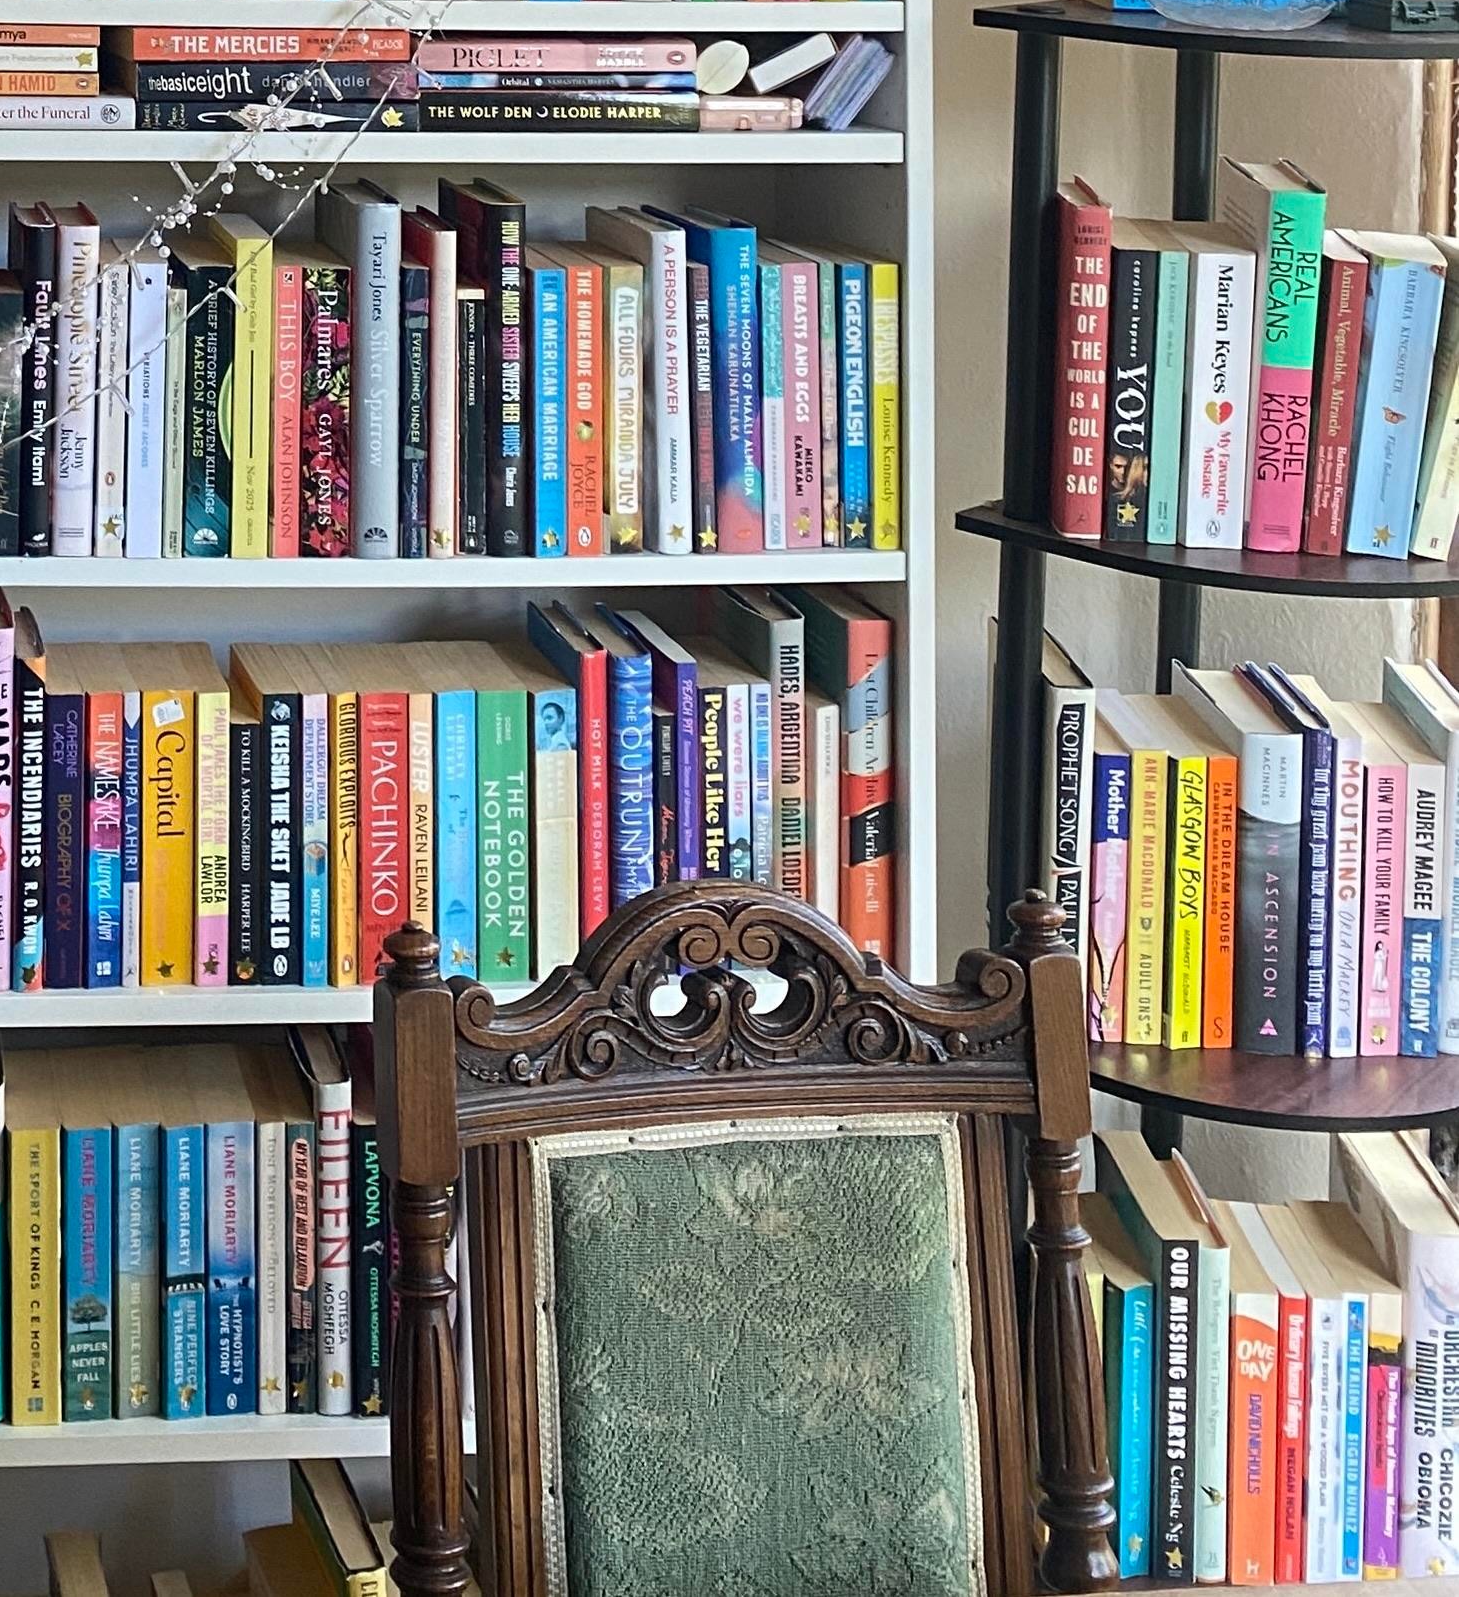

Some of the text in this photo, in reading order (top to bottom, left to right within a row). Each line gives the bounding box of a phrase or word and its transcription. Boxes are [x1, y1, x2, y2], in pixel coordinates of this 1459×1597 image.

[429, 106, 662, 120] THE WOLF DEN ELODIE HARPER
[1213, 264, 1234, 394] Marian Keyes
[1265, 211, 1293, 343] AMERICANS
[1294, 253, 1317, 306] REAL
[315, 290, 338, 390] Palmares
[794, 275, 809, 422] BREASTS AND EGGS
[845, 279, 863, 446] PIGEON ENGLISH
[317, 414, 331, 525] GAYL JONES
[1257, 392, 1284, 481] KHONG
[1282, 394, 1308, 483] RACHEL
[371, 740, 398, 916] PACHINKO
[701, 694, 723, 871] People Like Her
[415, 804, 428, 912] RAVEN LEILANI
[484, 781, 501, 928] NOTEBOOK
[507, 771, 525, 937] THE GOLDEN
[1414, 789, 1435, 911] AUDREY MAGEE
[1410, 932, 1432, 1033] THE COLONY
[318, 1109, 351, 1269] EILEEN
[364, 1141, 379, 1228] LAPVONA
[323, 1282, 335, 1355] MOSHFEGH
[338, 1290, 349, 1345] OTTESSA
[1167, 1248, 1189, 1460] OUR MISSING HEARTS
